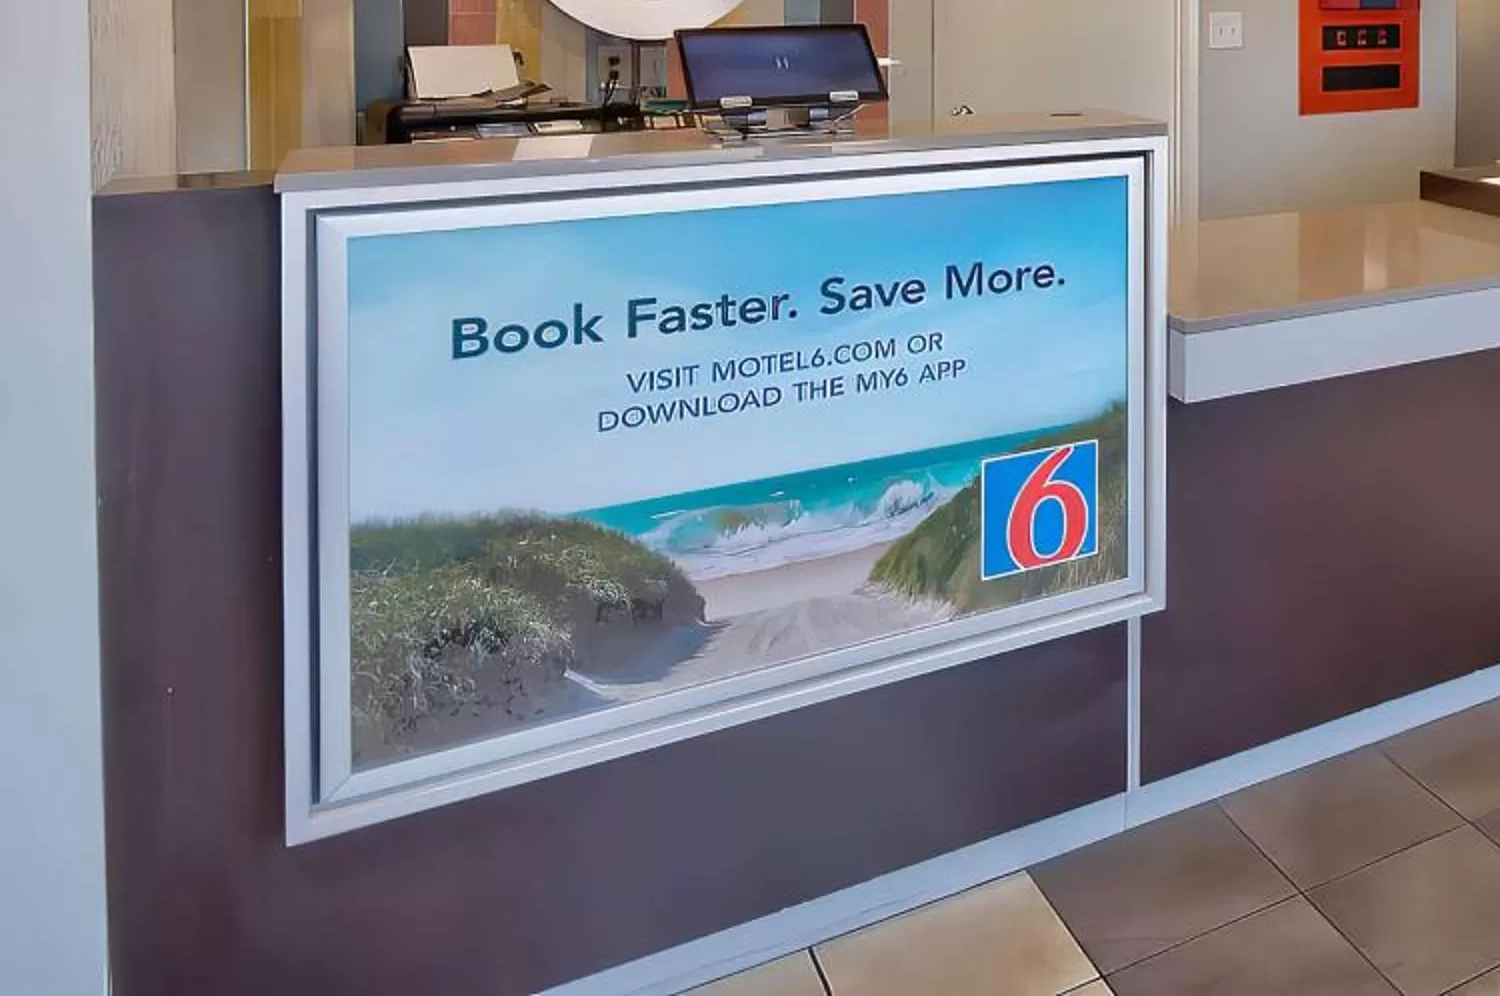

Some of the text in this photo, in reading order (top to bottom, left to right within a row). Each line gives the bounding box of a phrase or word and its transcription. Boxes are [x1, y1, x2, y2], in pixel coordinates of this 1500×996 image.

[452, 261, 1065, 359] Book Faster. Save More.
[597, 358, 966, 432] DOWNLOAD THE MY6 APP
[627, 332, 943, 393] VISIT MOTEL6.COM OR
[1006, 444, 1089, 571] 6
